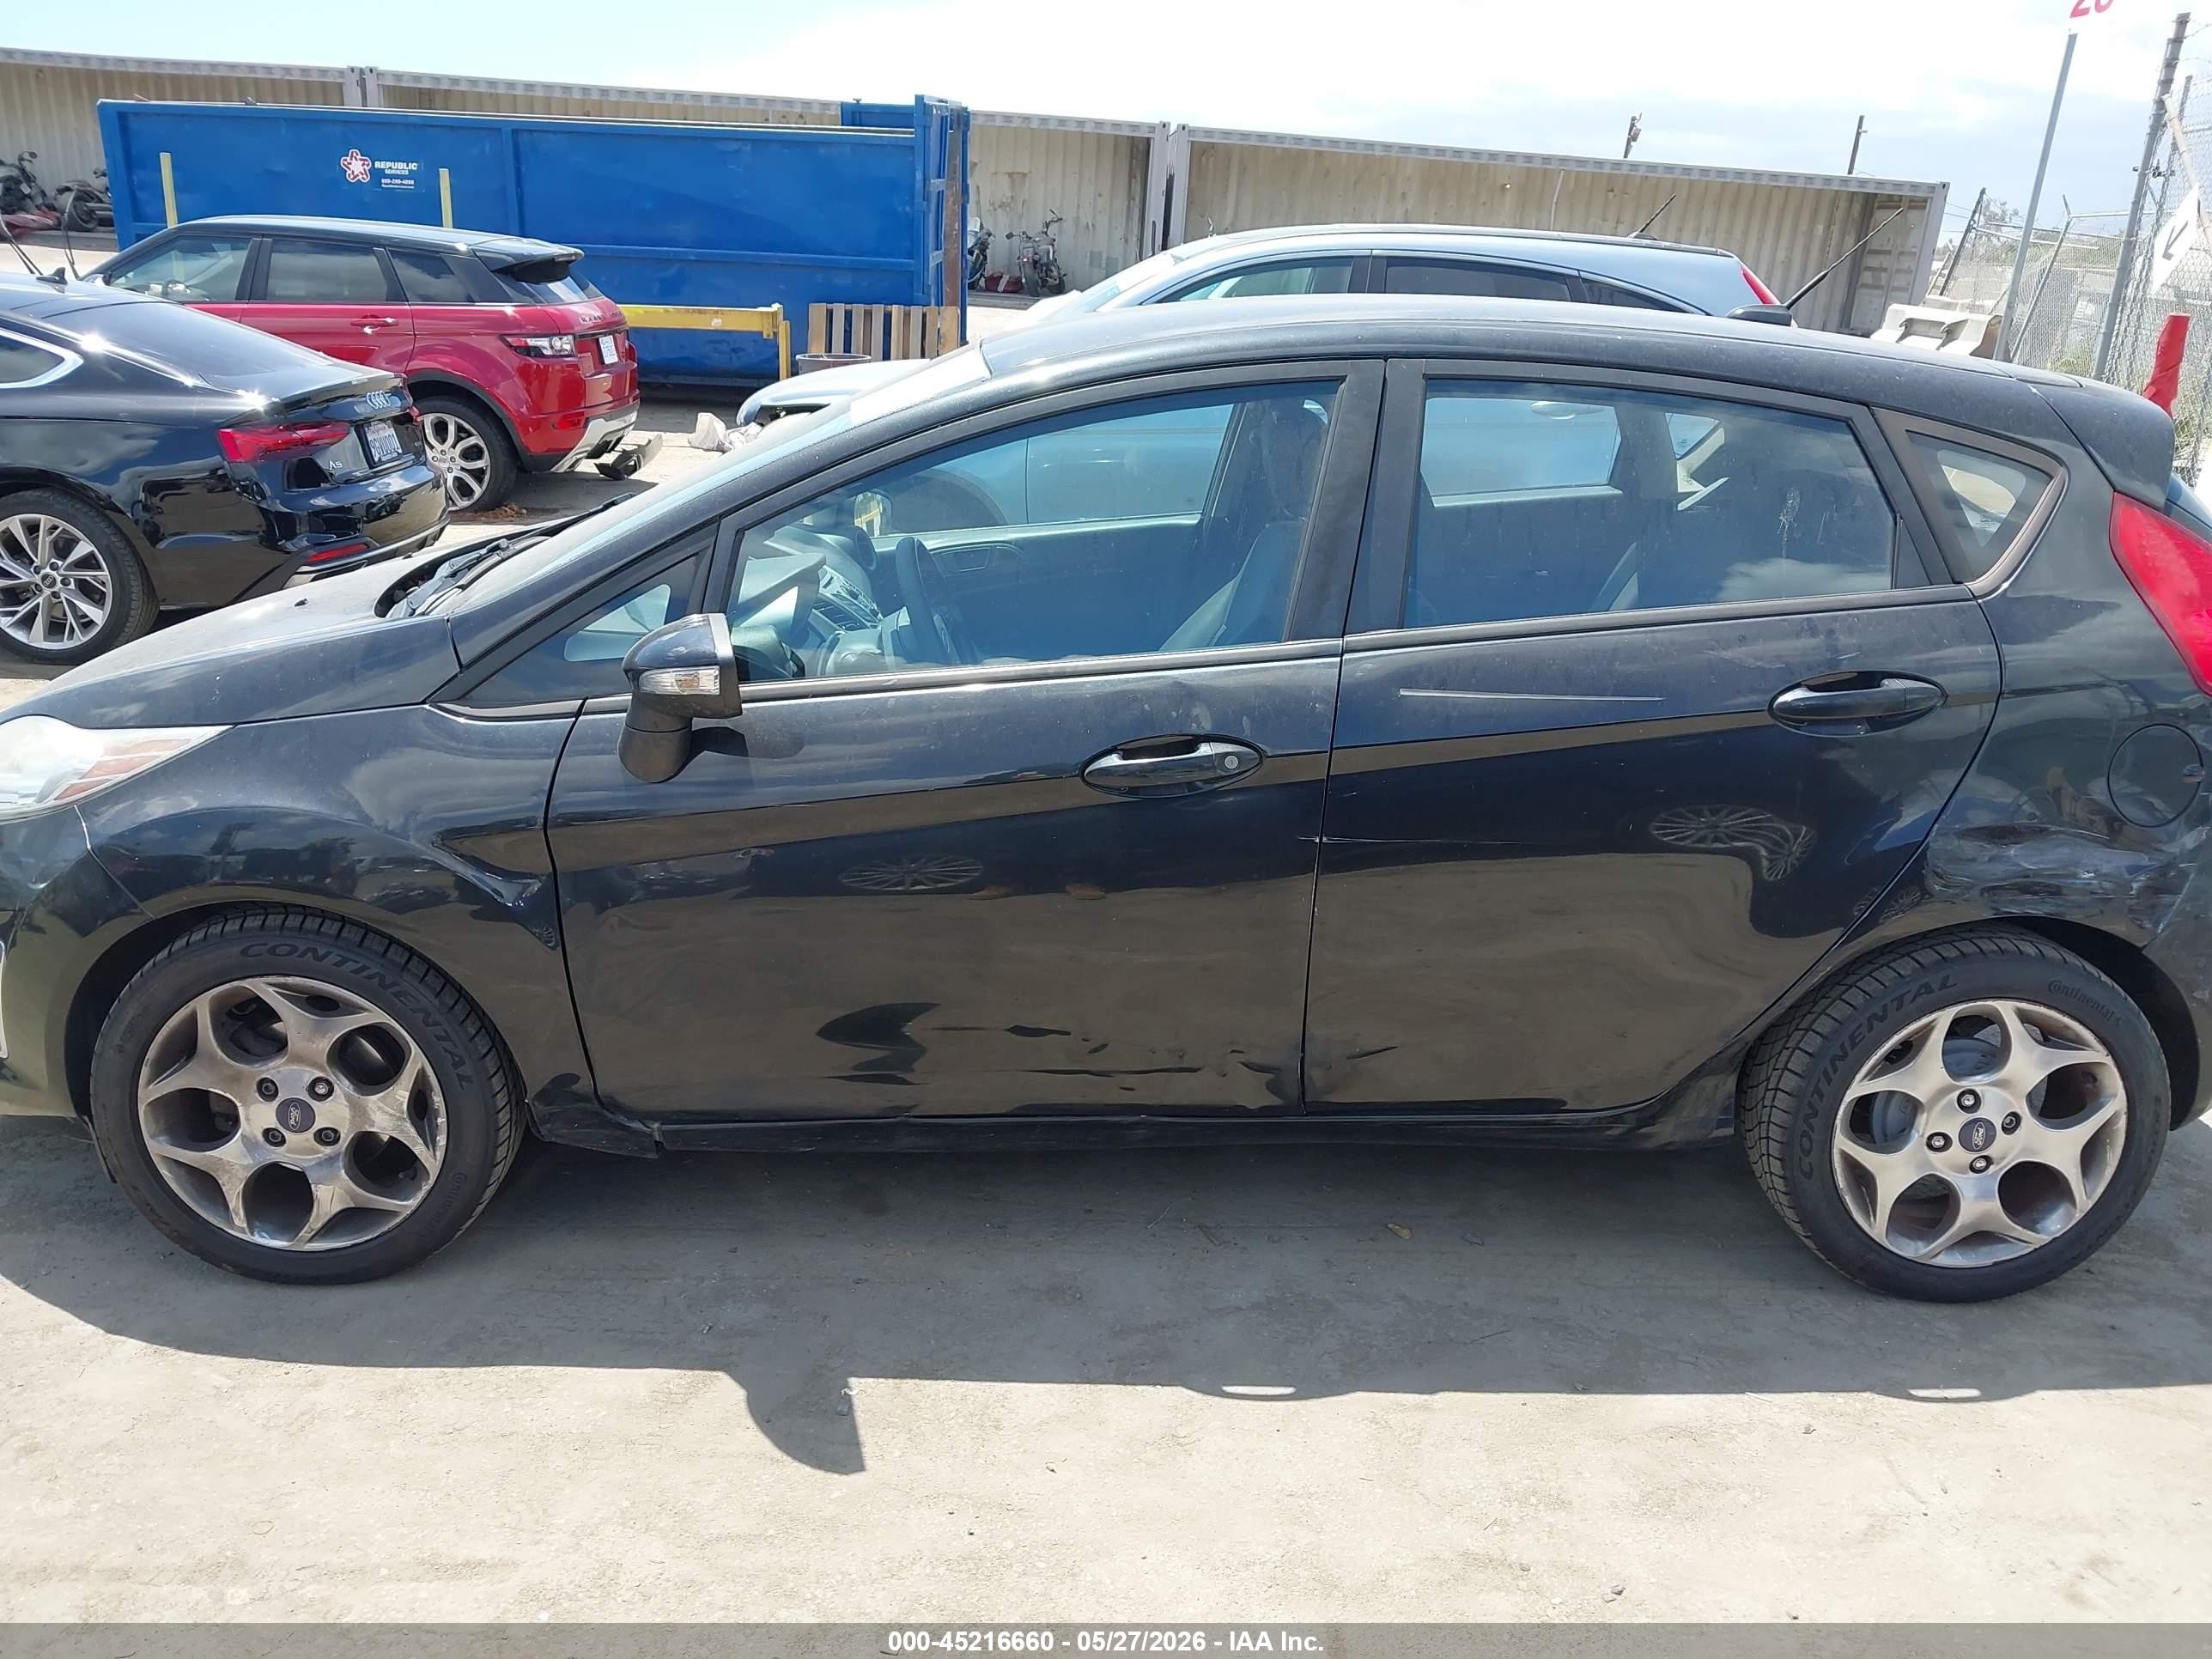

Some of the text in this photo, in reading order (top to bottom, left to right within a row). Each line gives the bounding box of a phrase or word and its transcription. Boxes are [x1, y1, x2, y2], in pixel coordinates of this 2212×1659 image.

[374, 161, 418, 170] REPUBLIC
[240, 943, 473, 1091] CONTINENTAL
[2048, 979, 2115, 1021] Continental
[1800, 975, 1957, 1180] CONTINENTAL
